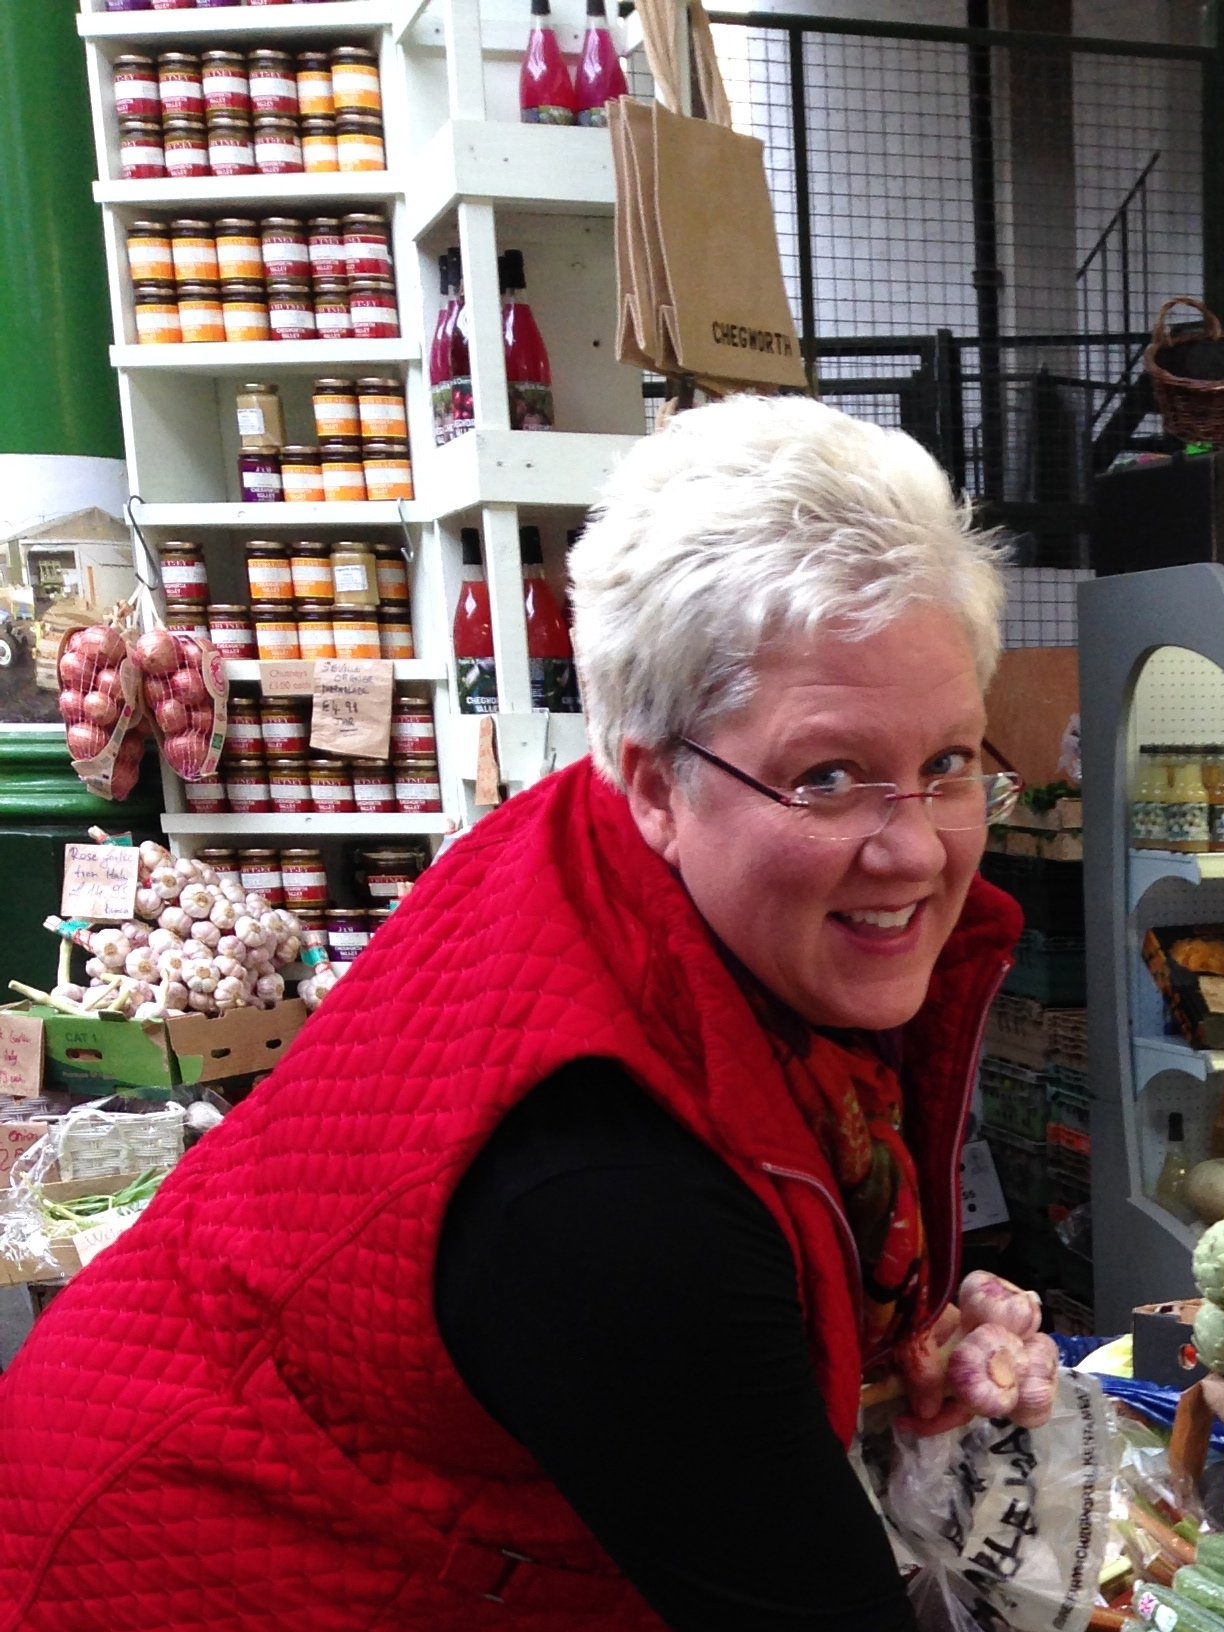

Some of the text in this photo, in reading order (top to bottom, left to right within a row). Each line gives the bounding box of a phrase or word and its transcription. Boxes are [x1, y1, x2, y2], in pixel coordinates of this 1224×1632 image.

[712, 321, 792, 356] CHEGWORTH
[69, 847, 97, 861] Rose
[65, 1032, 88, 1043] CAT
